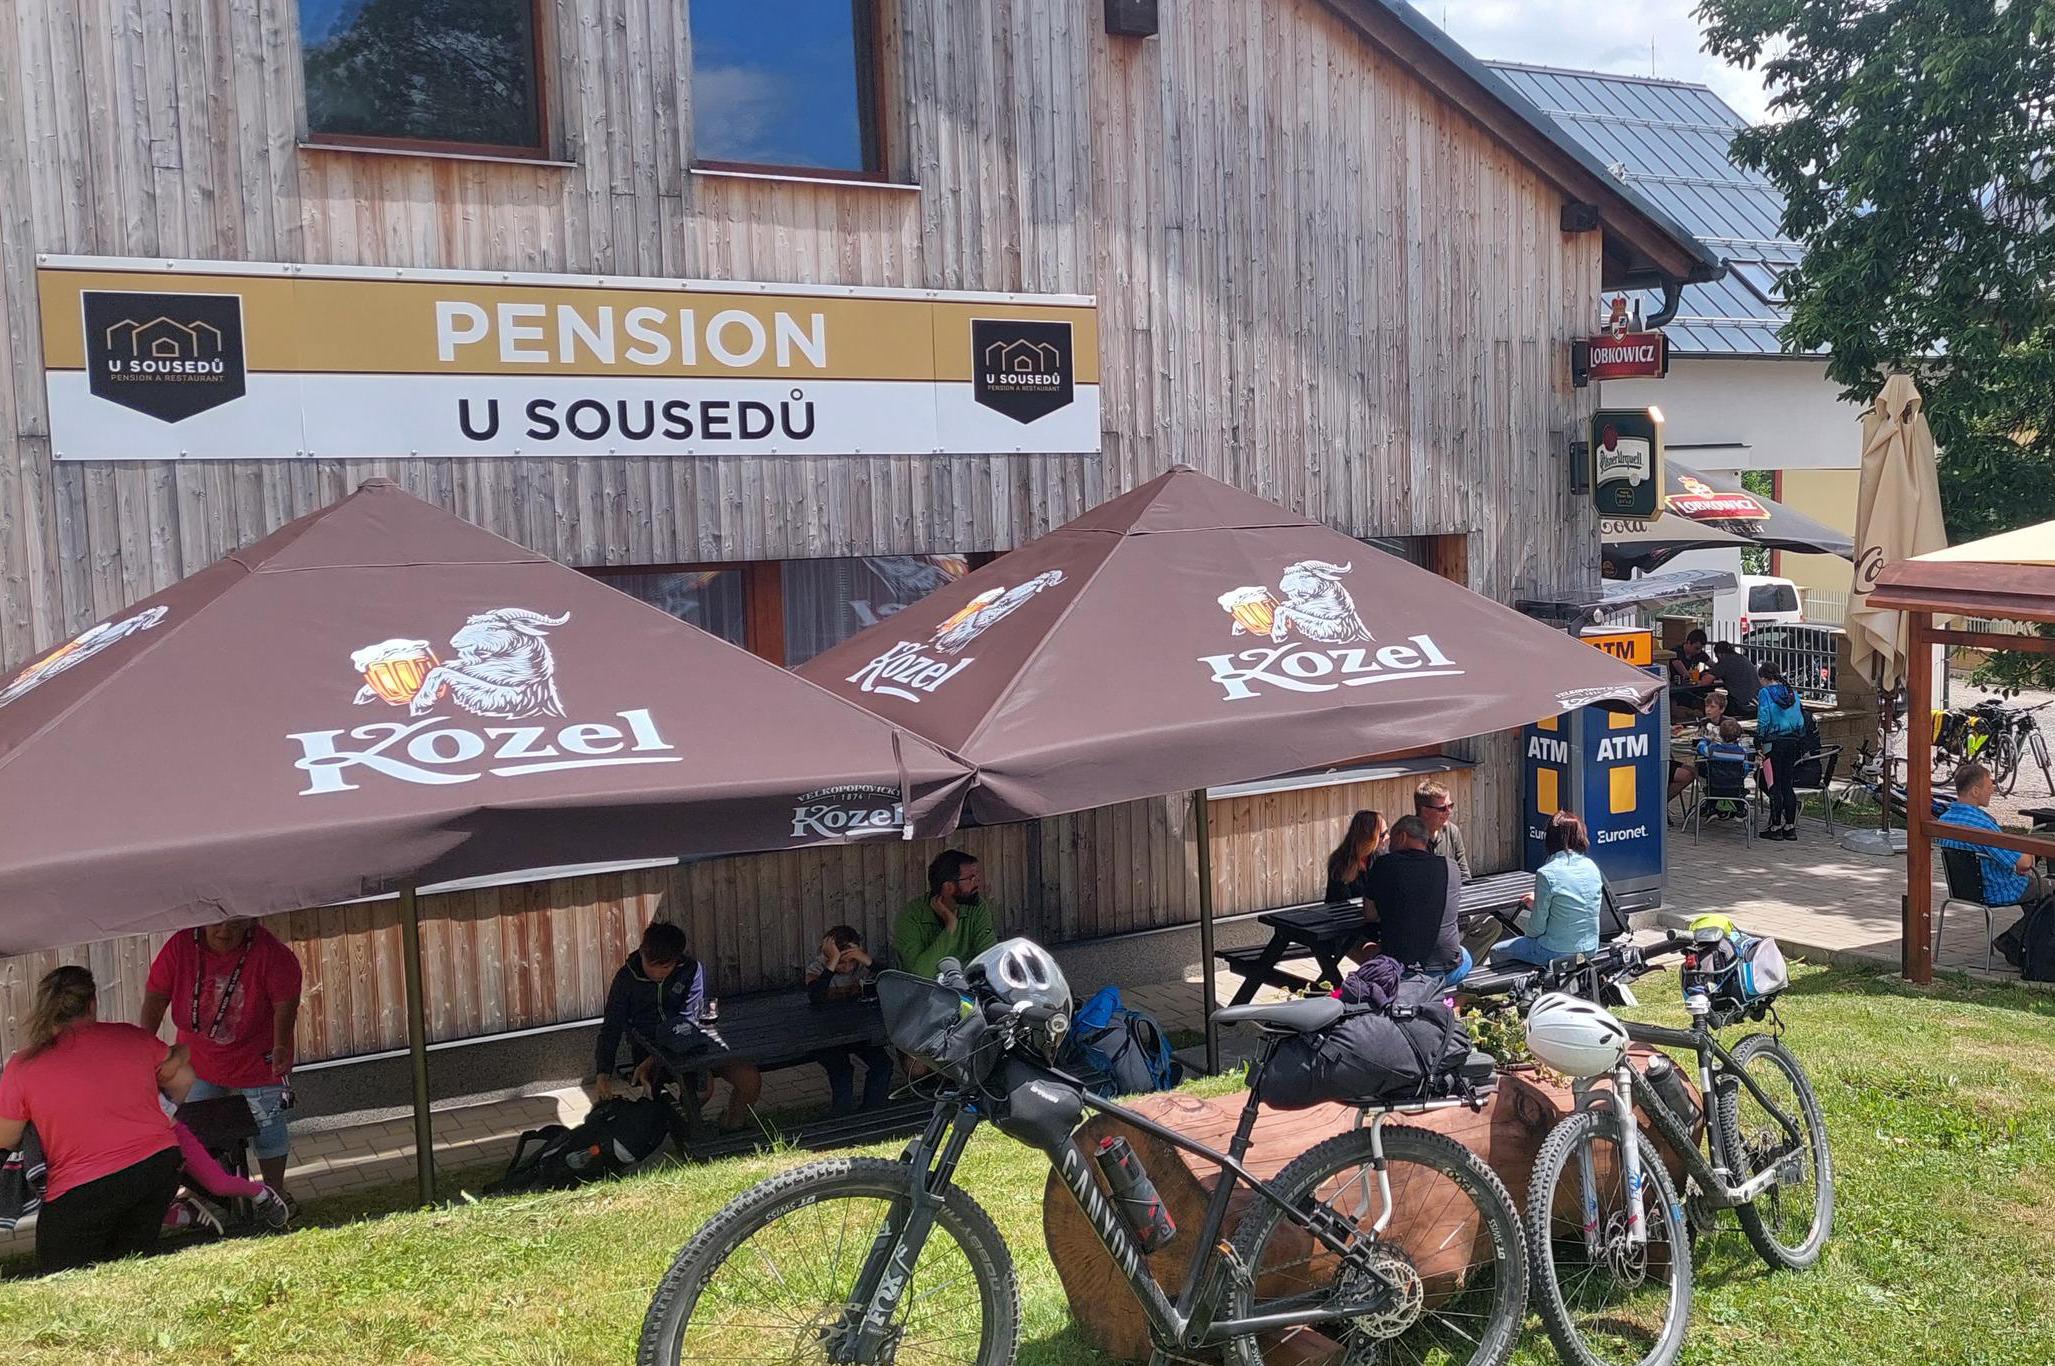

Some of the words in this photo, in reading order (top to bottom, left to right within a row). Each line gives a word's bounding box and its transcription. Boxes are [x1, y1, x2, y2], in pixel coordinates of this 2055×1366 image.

[435, 301, 827, 369] PENSION
[108, 360, 121, 372] U
[130, 358, 223, 373] SOUSEDŮ
[1590, 345, 1654, 368] LOBKOWICZ
[111, 374, 152, 382] PENSION
[164, 374, 224, 383] RESTAURANT
[986, 374, 994, 384] U
[1000, 372, 1060, 385] SOUSEDŮ
[458, 399, 499, 440] U
[526, 388, 815, 441] SOUSEDŮ
[1675, 500, 1757, 514] LOBKOWICZ
[845, 641, 975, 700] Kozel
[1198, 634, 1460, 701] Kozel
[286, 709, 679, 796] Kozel
[1528, 736, 1568, 764] ATM
[1596, 734, 1648, 762] ATM
[790, 802, 904, 838] Kozel
[766, 1202, 796, 1222] SWISS
[799, 1195, 816, 1207] DT
[1062, 1149, 1139, 1280] CANYON
[1488, 1218, 1503, 1244] SWISS
[1496, 1243, 1506, 1260] DT
[867, 1273, 905, 1328] FOX
